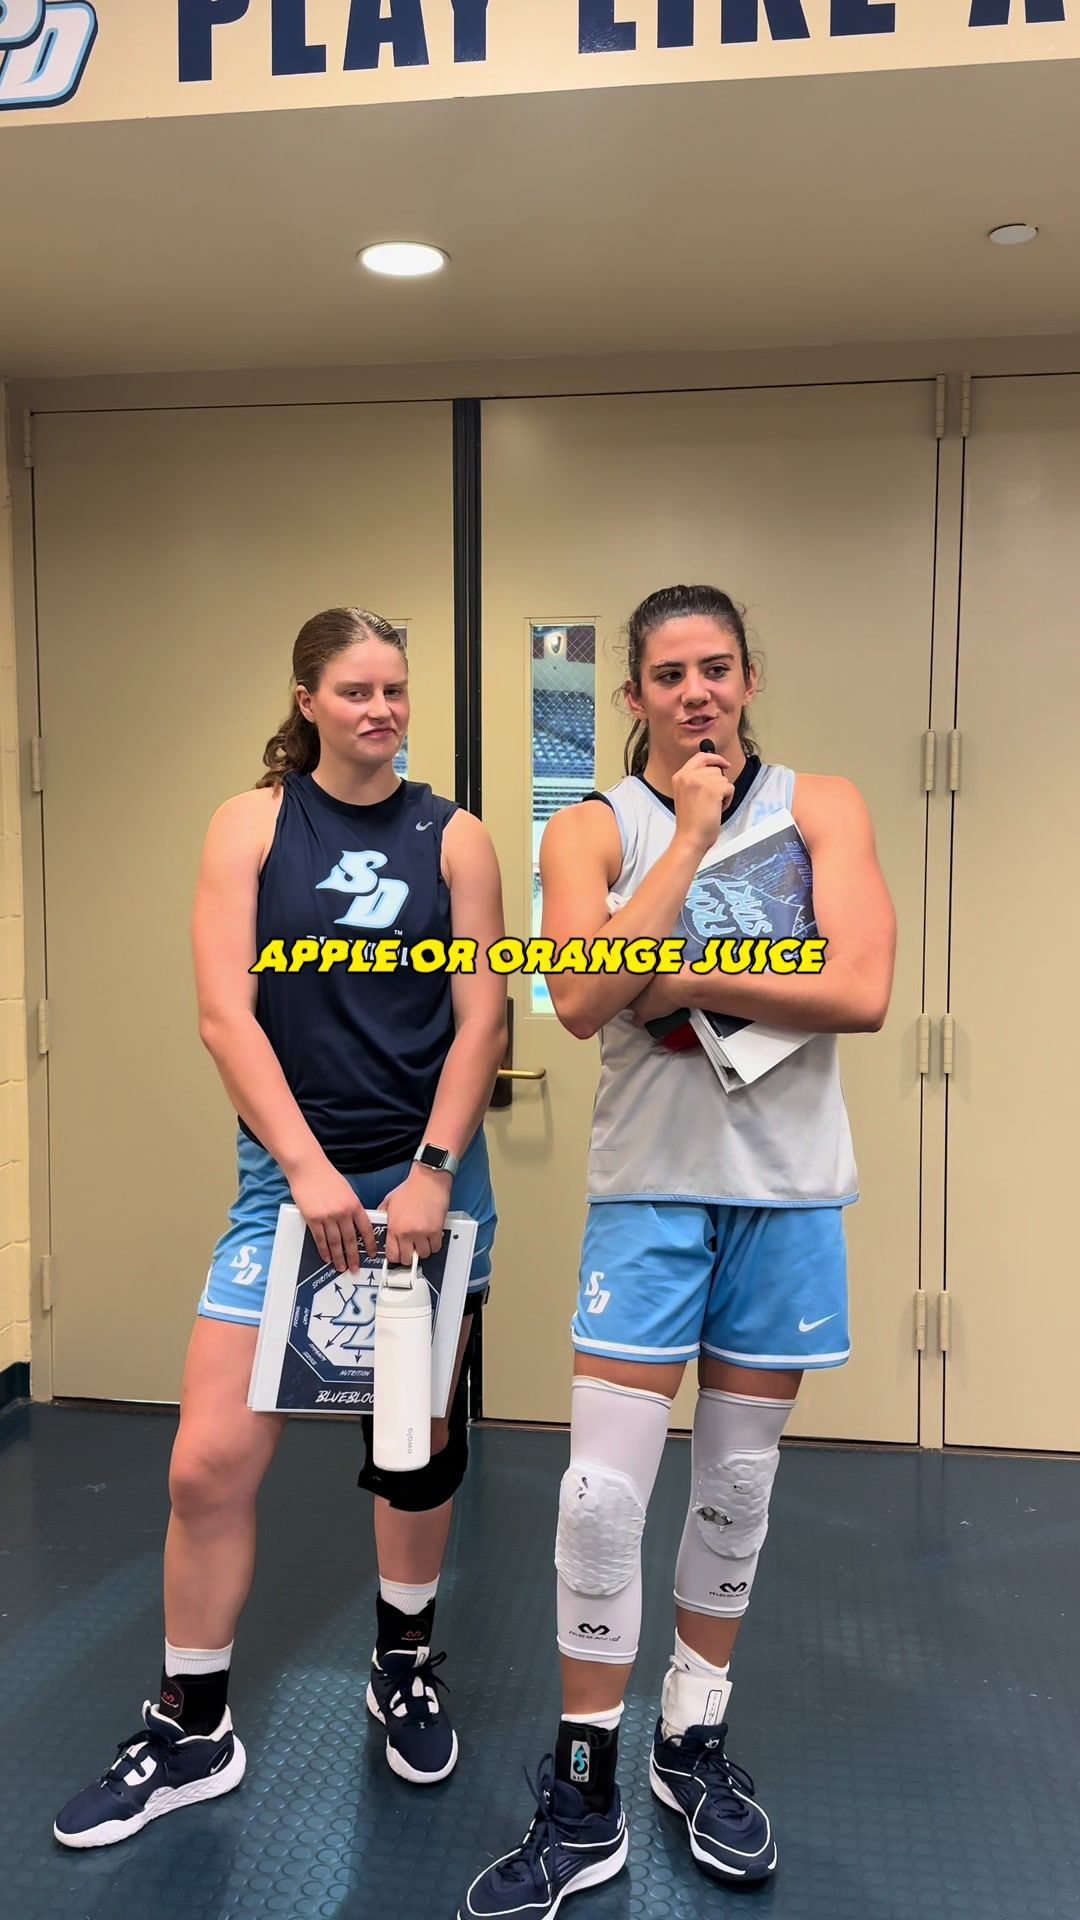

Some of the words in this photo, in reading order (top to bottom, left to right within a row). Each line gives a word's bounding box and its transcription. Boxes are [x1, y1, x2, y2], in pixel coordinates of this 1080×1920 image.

[714, 878, 773, 937] START
[584, 1271, 611, 1314] SD
[339, 1369, 371, 1377] NUTRITION
[406, 1427, 414, 1455] owala
